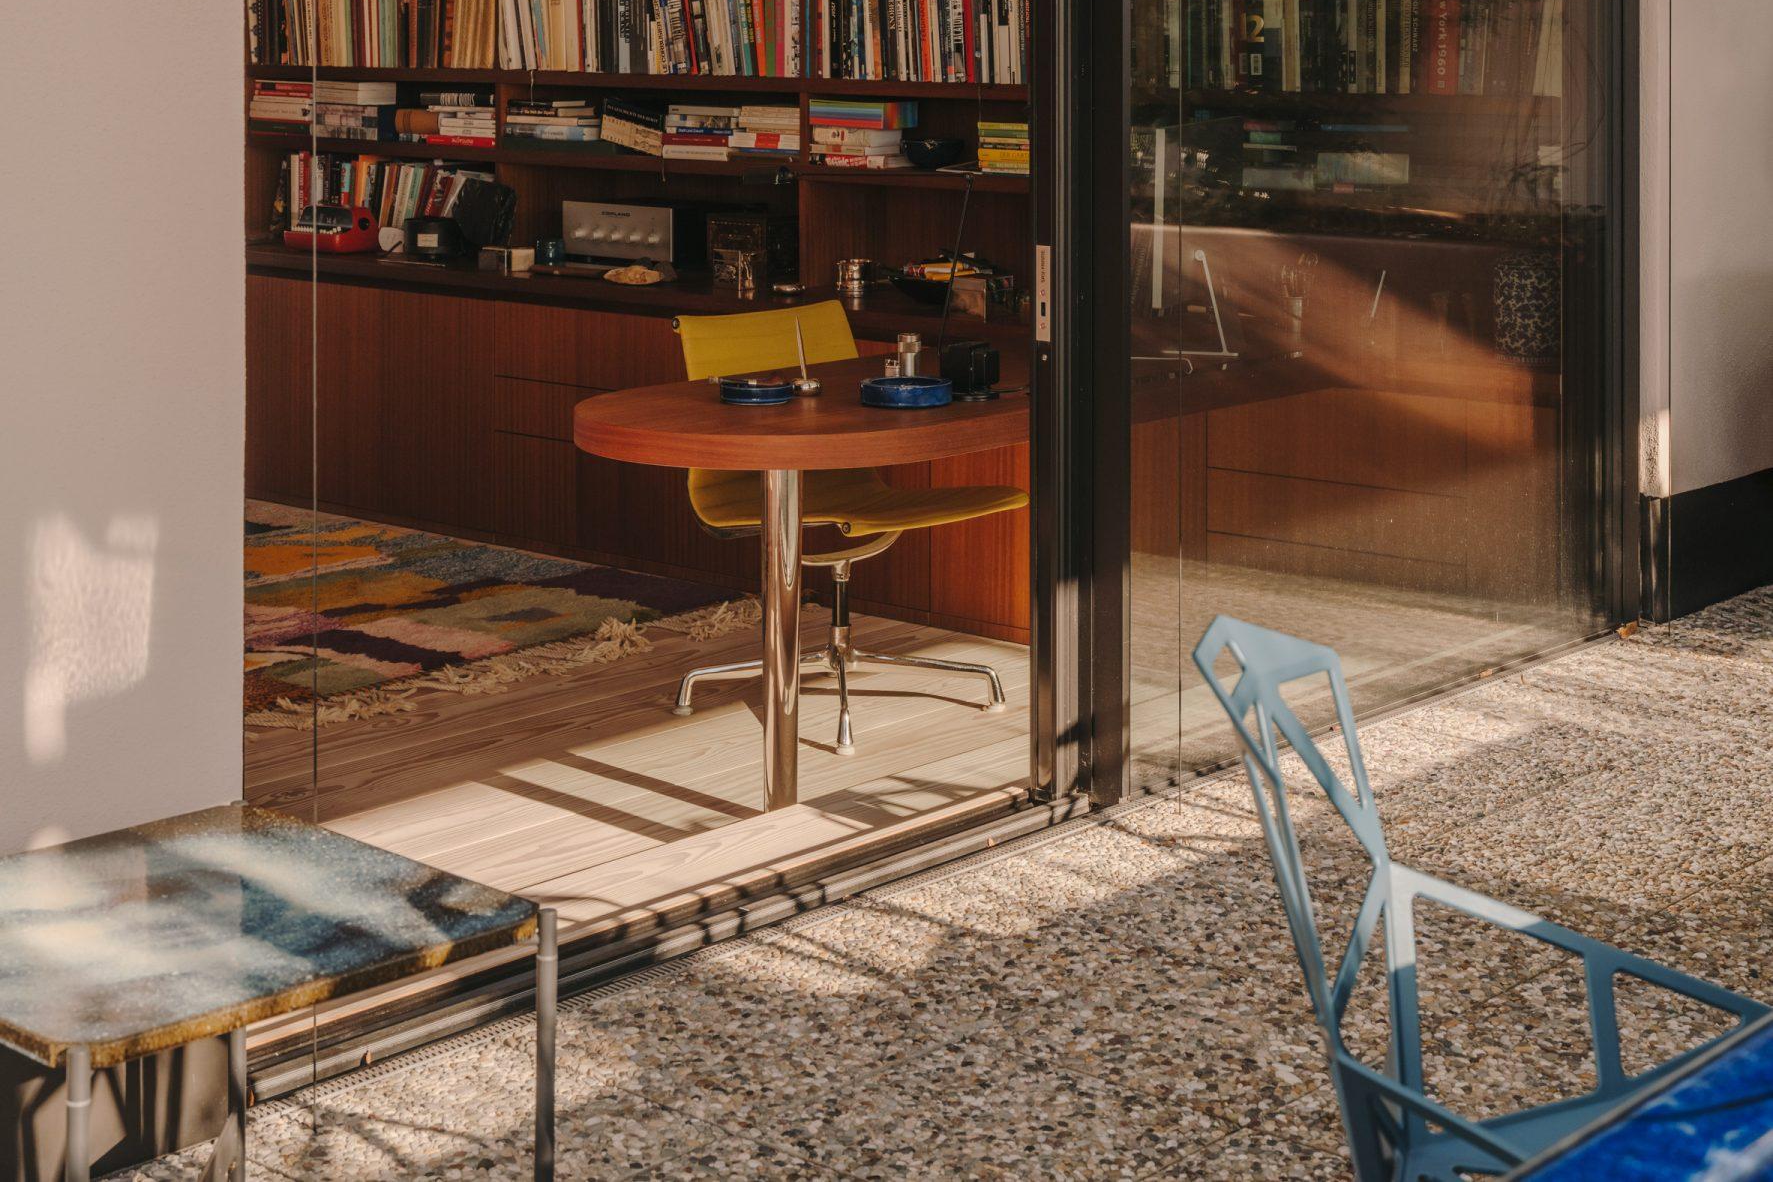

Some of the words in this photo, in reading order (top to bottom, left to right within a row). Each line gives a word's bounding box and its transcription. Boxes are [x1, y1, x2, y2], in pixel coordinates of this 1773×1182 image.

[1411, 17, 1419, 53] SCHWARZ
[1436, 12, 1448, 40] York
[1436, 43, 1448, 76] 1960
